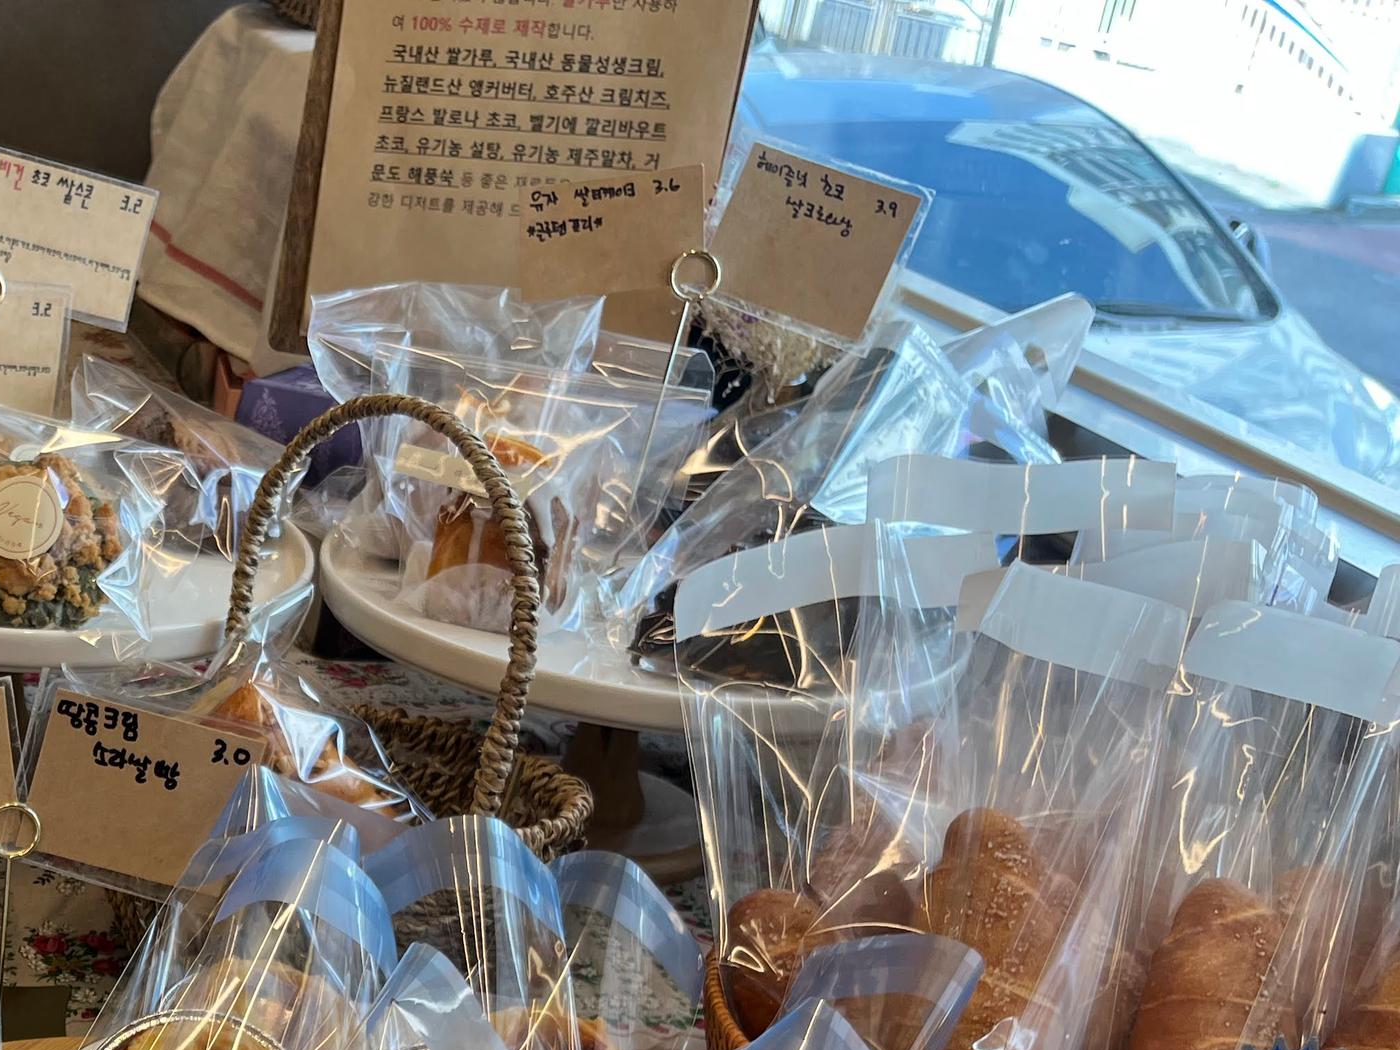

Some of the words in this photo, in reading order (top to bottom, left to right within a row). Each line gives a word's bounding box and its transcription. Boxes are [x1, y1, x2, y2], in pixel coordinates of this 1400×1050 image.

[412, 16, 450, 31] 100%
[459, 17, 505, 35] 수제로
[515, 18, 594, 41] 제작합니다.
[393, 44, 440, 63] 국내산
[446, 47, 497, 68] 쌀가루,
[505, 51, 553, 70] 국내산
[561, 54, 664, 77] 동물성생크림,
[384, 74, 462, 95] 뉴질랜드산
[469, 79, 537, 101] 앵커버터,
[544, 84, 594, 104] 호주산
[601, 88, 670, 109] 크림치즈,
[379, 105, 425, 123] 프랑스
[433, 108, 479, 127] 발로나
[487, 112, 521, 130] 초코,
[530, 114, 577, 132] 벨기에
[586, 117, 667, 138] 깔리바우트
[375, 135, 410, 154] 초코,
[416, 138, 464, 157] 유기농
[470, 142, 505, 161] 설탕,
[513, 145, 561, 163] 유기농
[567, 148, 637, 170] 제주말차,
[372, 164, 402, 181] 문도
[408, 166, 457, 184] 해풍쑥
[480, 173, 507, 191] 좋은
[653, 177, 680, 194] 3.6
[756, 151, 808, 187] 헤이즐넛
[874, 199, 898, 218] 3.9
[56, 177, 94, 209] 쌀스콘
[119, 195, 143, 214] 3.2
[400, 195, 455, 214] 디저트를
[32, 302, 52, 317] 3.2
[211, 738, 251, 766] 3.0
